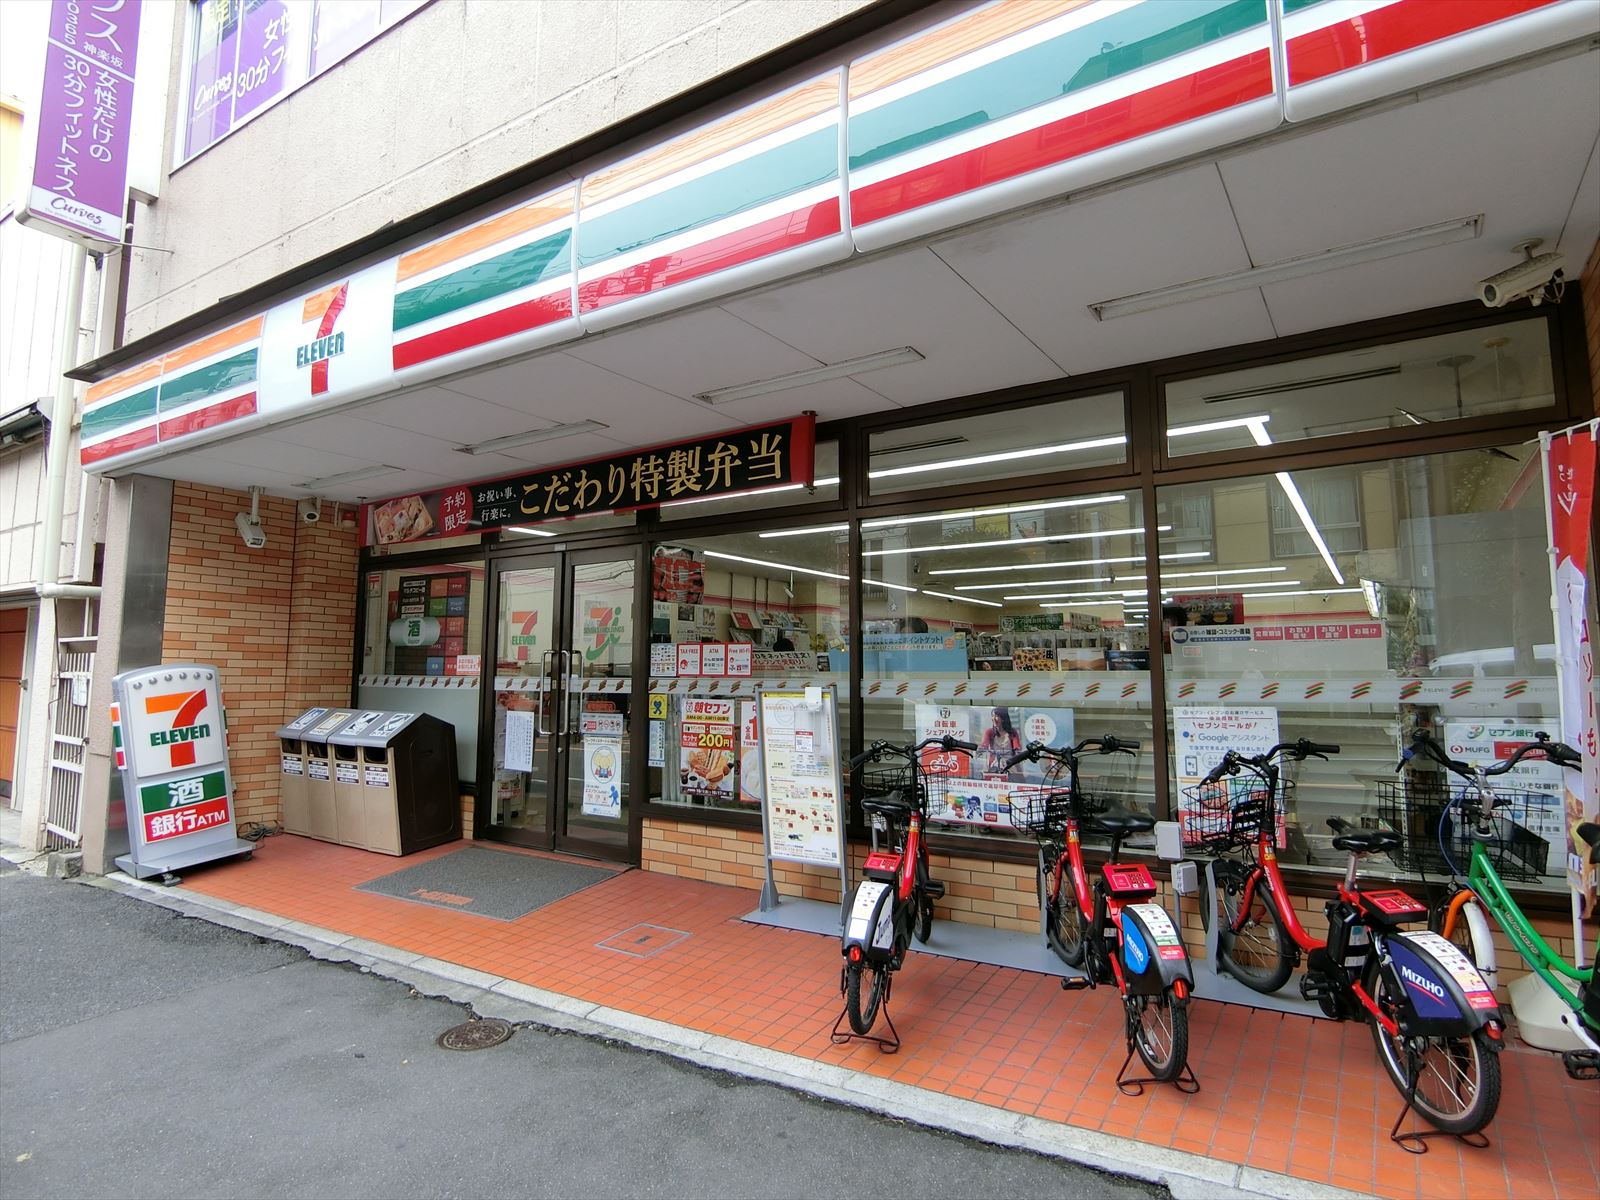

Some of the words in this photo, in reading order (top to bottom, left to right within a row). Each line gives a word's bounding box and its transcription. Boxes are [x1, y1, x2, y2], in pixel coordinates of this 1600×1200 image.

[83, 41, 124, 69] 神楽坂
[194, 71, 233, 111] Curves
[53, 54, 91, 197] 30分フィットネス
[89, 69, 120, 163] 女性だけの
[50, 197, 103, 225] Curves
[302, 280, 349, 396] 7
[520, 433, 783, 516] こだわり特製弁当
[444, 490, 467, 513] 予約
[444, 509, 468, 532] 限定
[408, 620, 421, 638] 酒
[511, 610, 538, 661] 7
[694, 701, 731, 715] 朝セブン
[144, 688, 208, 768] 7
[925, 728, 966, 737] シェアリング
[934, 720, 957, 728] 自転車
[1198, 733, 1229, 743] Google
[1488, 728, 1534, 737] セブン銀行
[698, 733, 730, 748] 200円
[168, 777, 205, 808] 酒
[151, 809, 226, 838] 銀行ATM
[1401, 965, 1444, 997] MIZUHO
